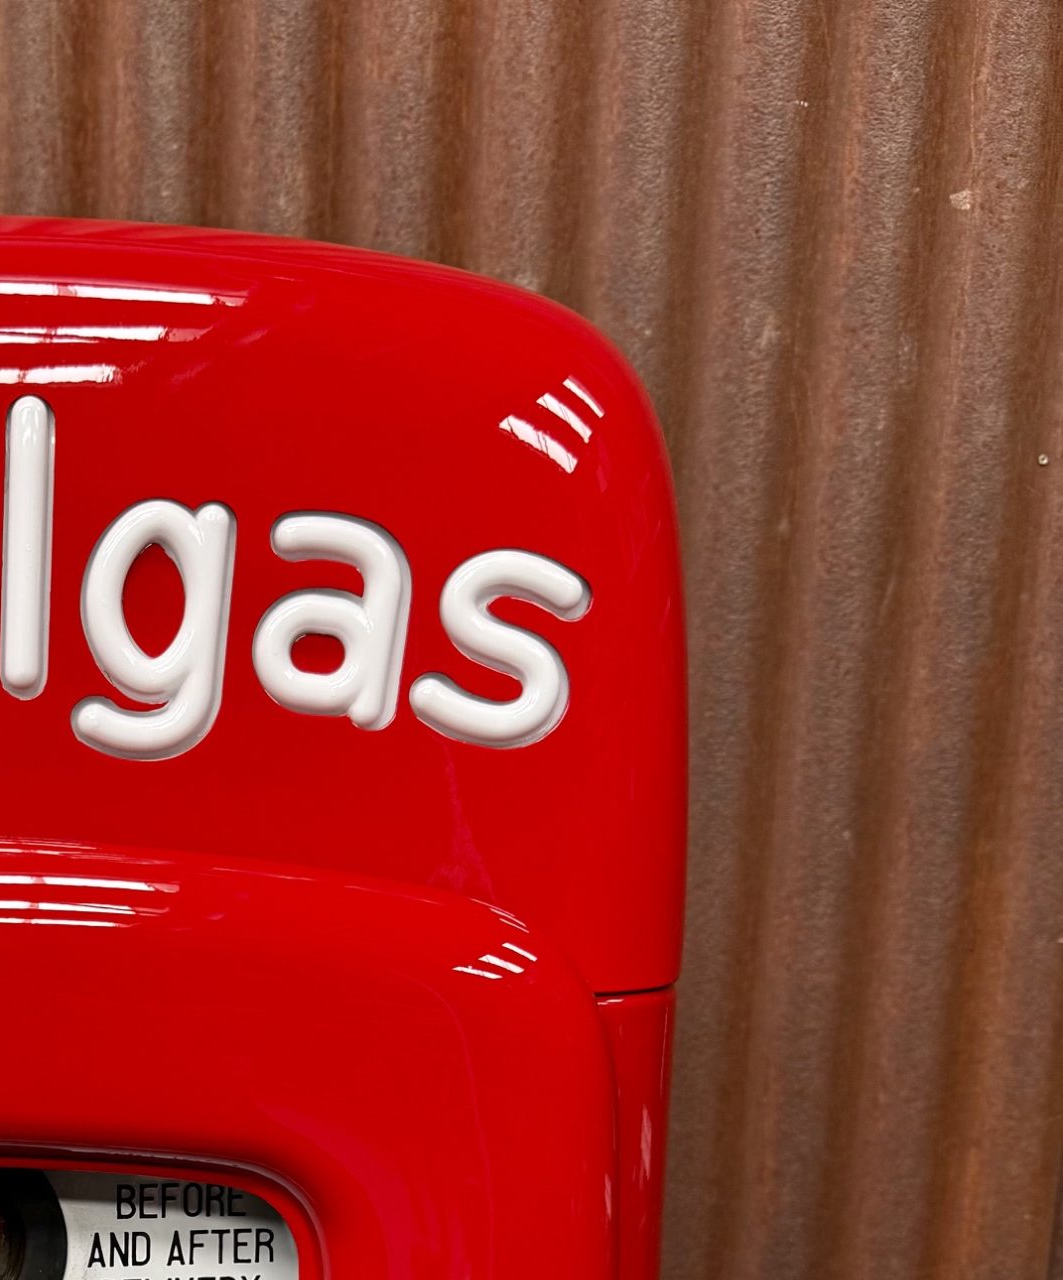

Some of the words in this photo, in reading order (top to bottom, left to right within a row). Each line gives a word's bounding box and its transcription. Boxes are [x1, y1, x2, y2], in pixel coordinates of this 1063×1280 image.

[116, 1182, 247, 1219] BEFORE
[88, 1231, 151, 1267] AND
[167, 1228, 274, 1266] AFTER
